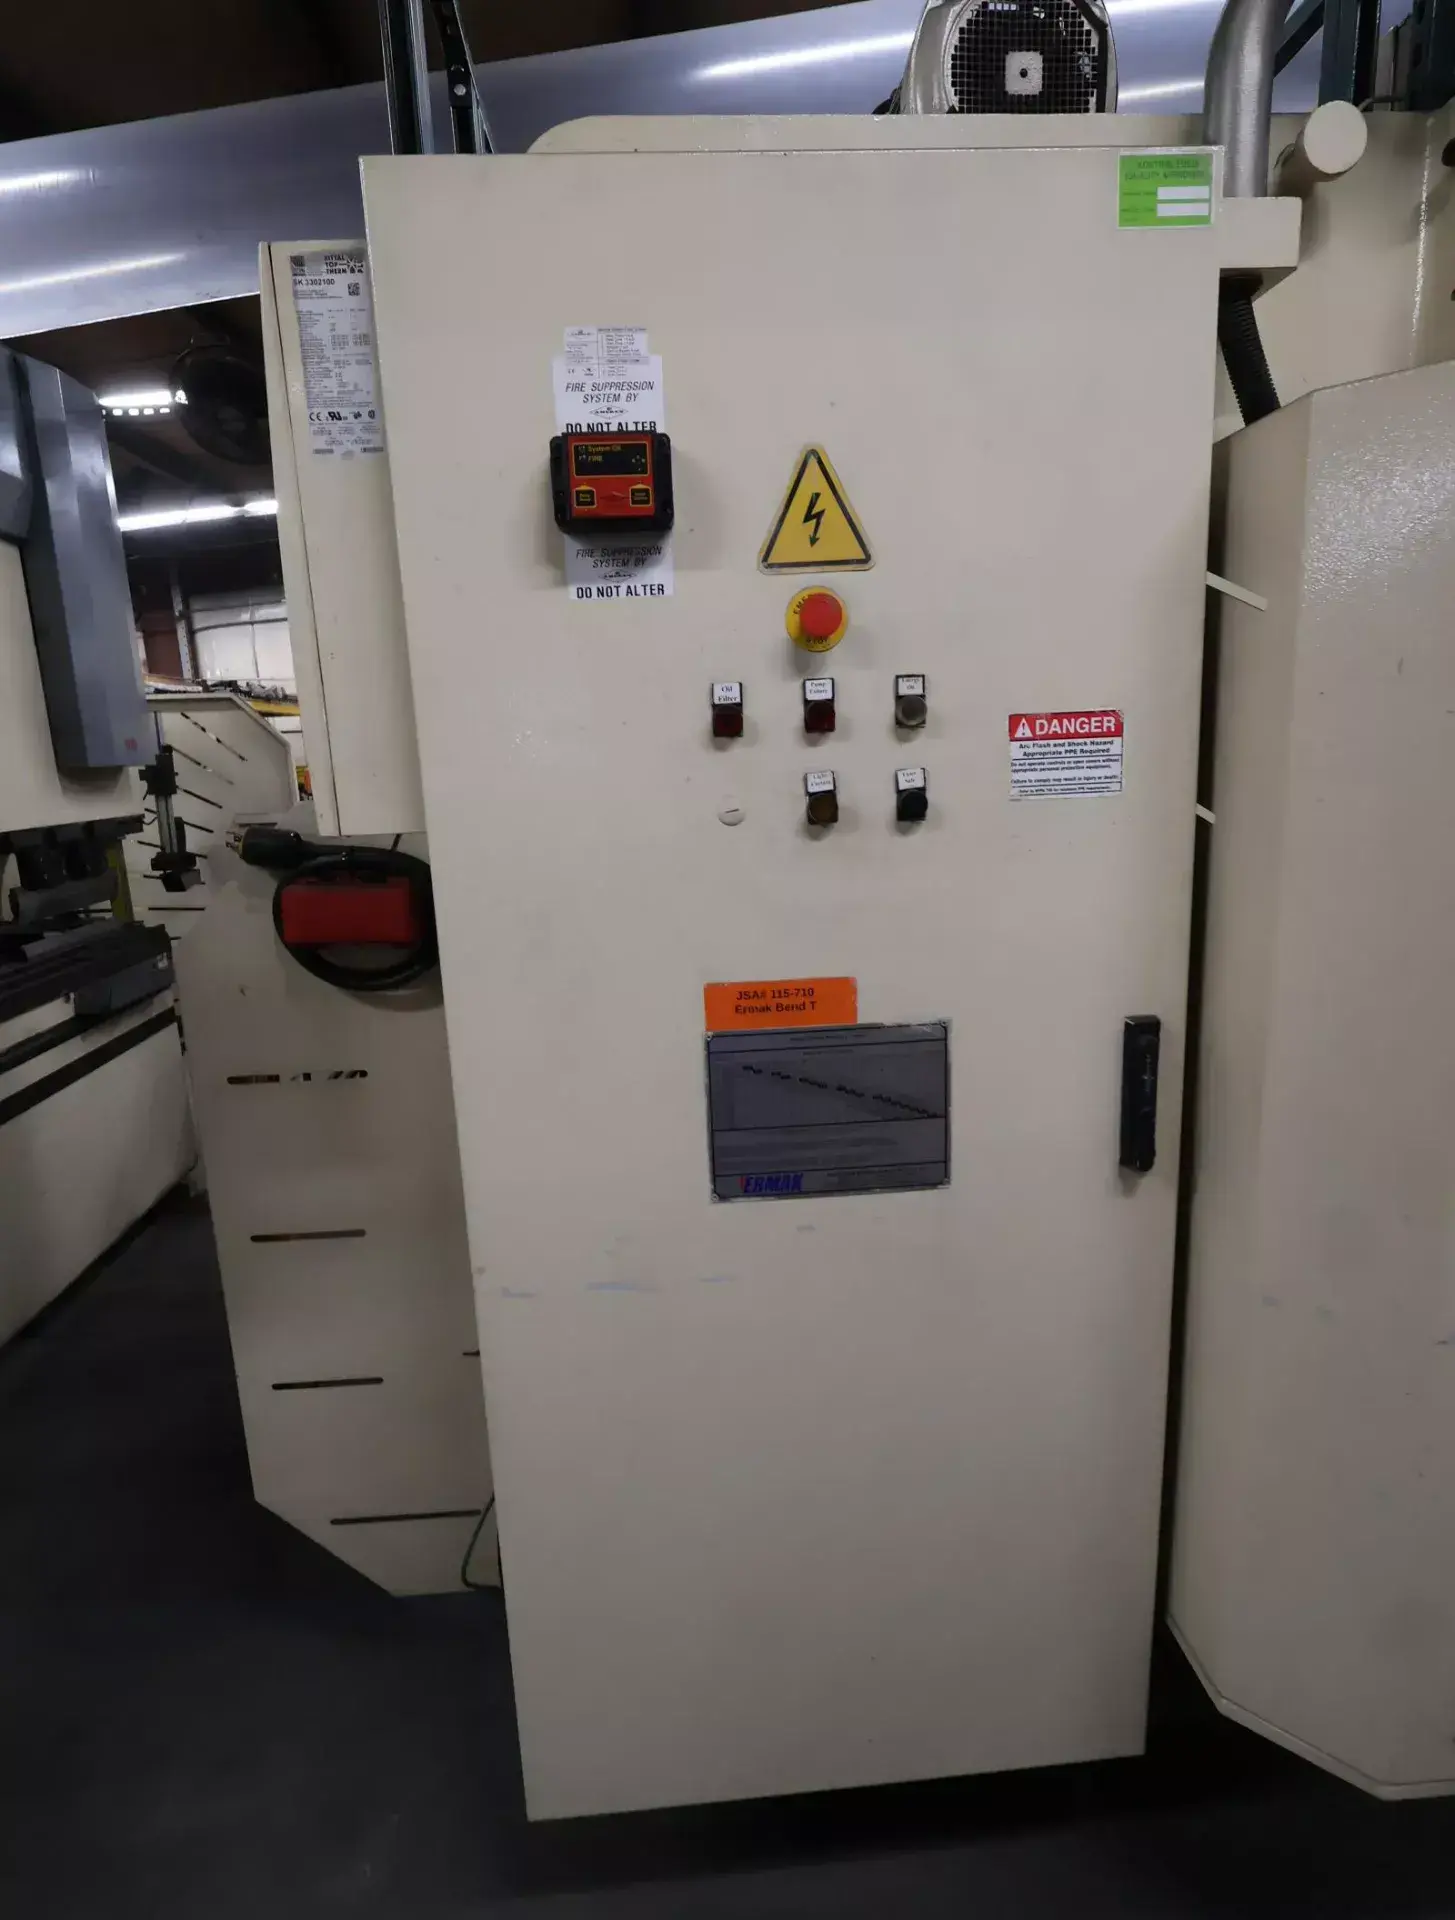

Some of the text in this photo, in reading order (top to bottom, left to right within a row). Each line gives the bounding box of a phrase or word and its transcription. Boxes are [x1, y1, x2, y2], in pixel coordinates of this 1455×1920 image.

[565, 381, 655, 392] FIRE SUPPRESSION
[582, 392, 639, 403] SYSTEM BY
[566, 421, 657, 433] DO NOT ALTER
[576, 546, 662, 559] FIRE SUPPRESSION
[592, 557, 648, 569] SYSTEM BY
[576, 583, 665, 599] DO NOT ALTER
[718, 695, 737, 703] Filter
[1035, 716, 1116, 735] DANGER
[1032, 741, 1051, 749] Flash
[1053, 740, 1066, 748] and
[1023, 749, 1062, 758] Appropriate
[736, 988, 815, 1001] JSA# 115-710
[734, 1001, 818, 1015] Ermak Bend T
[743, 1173, 804, 1194] ERMAK
